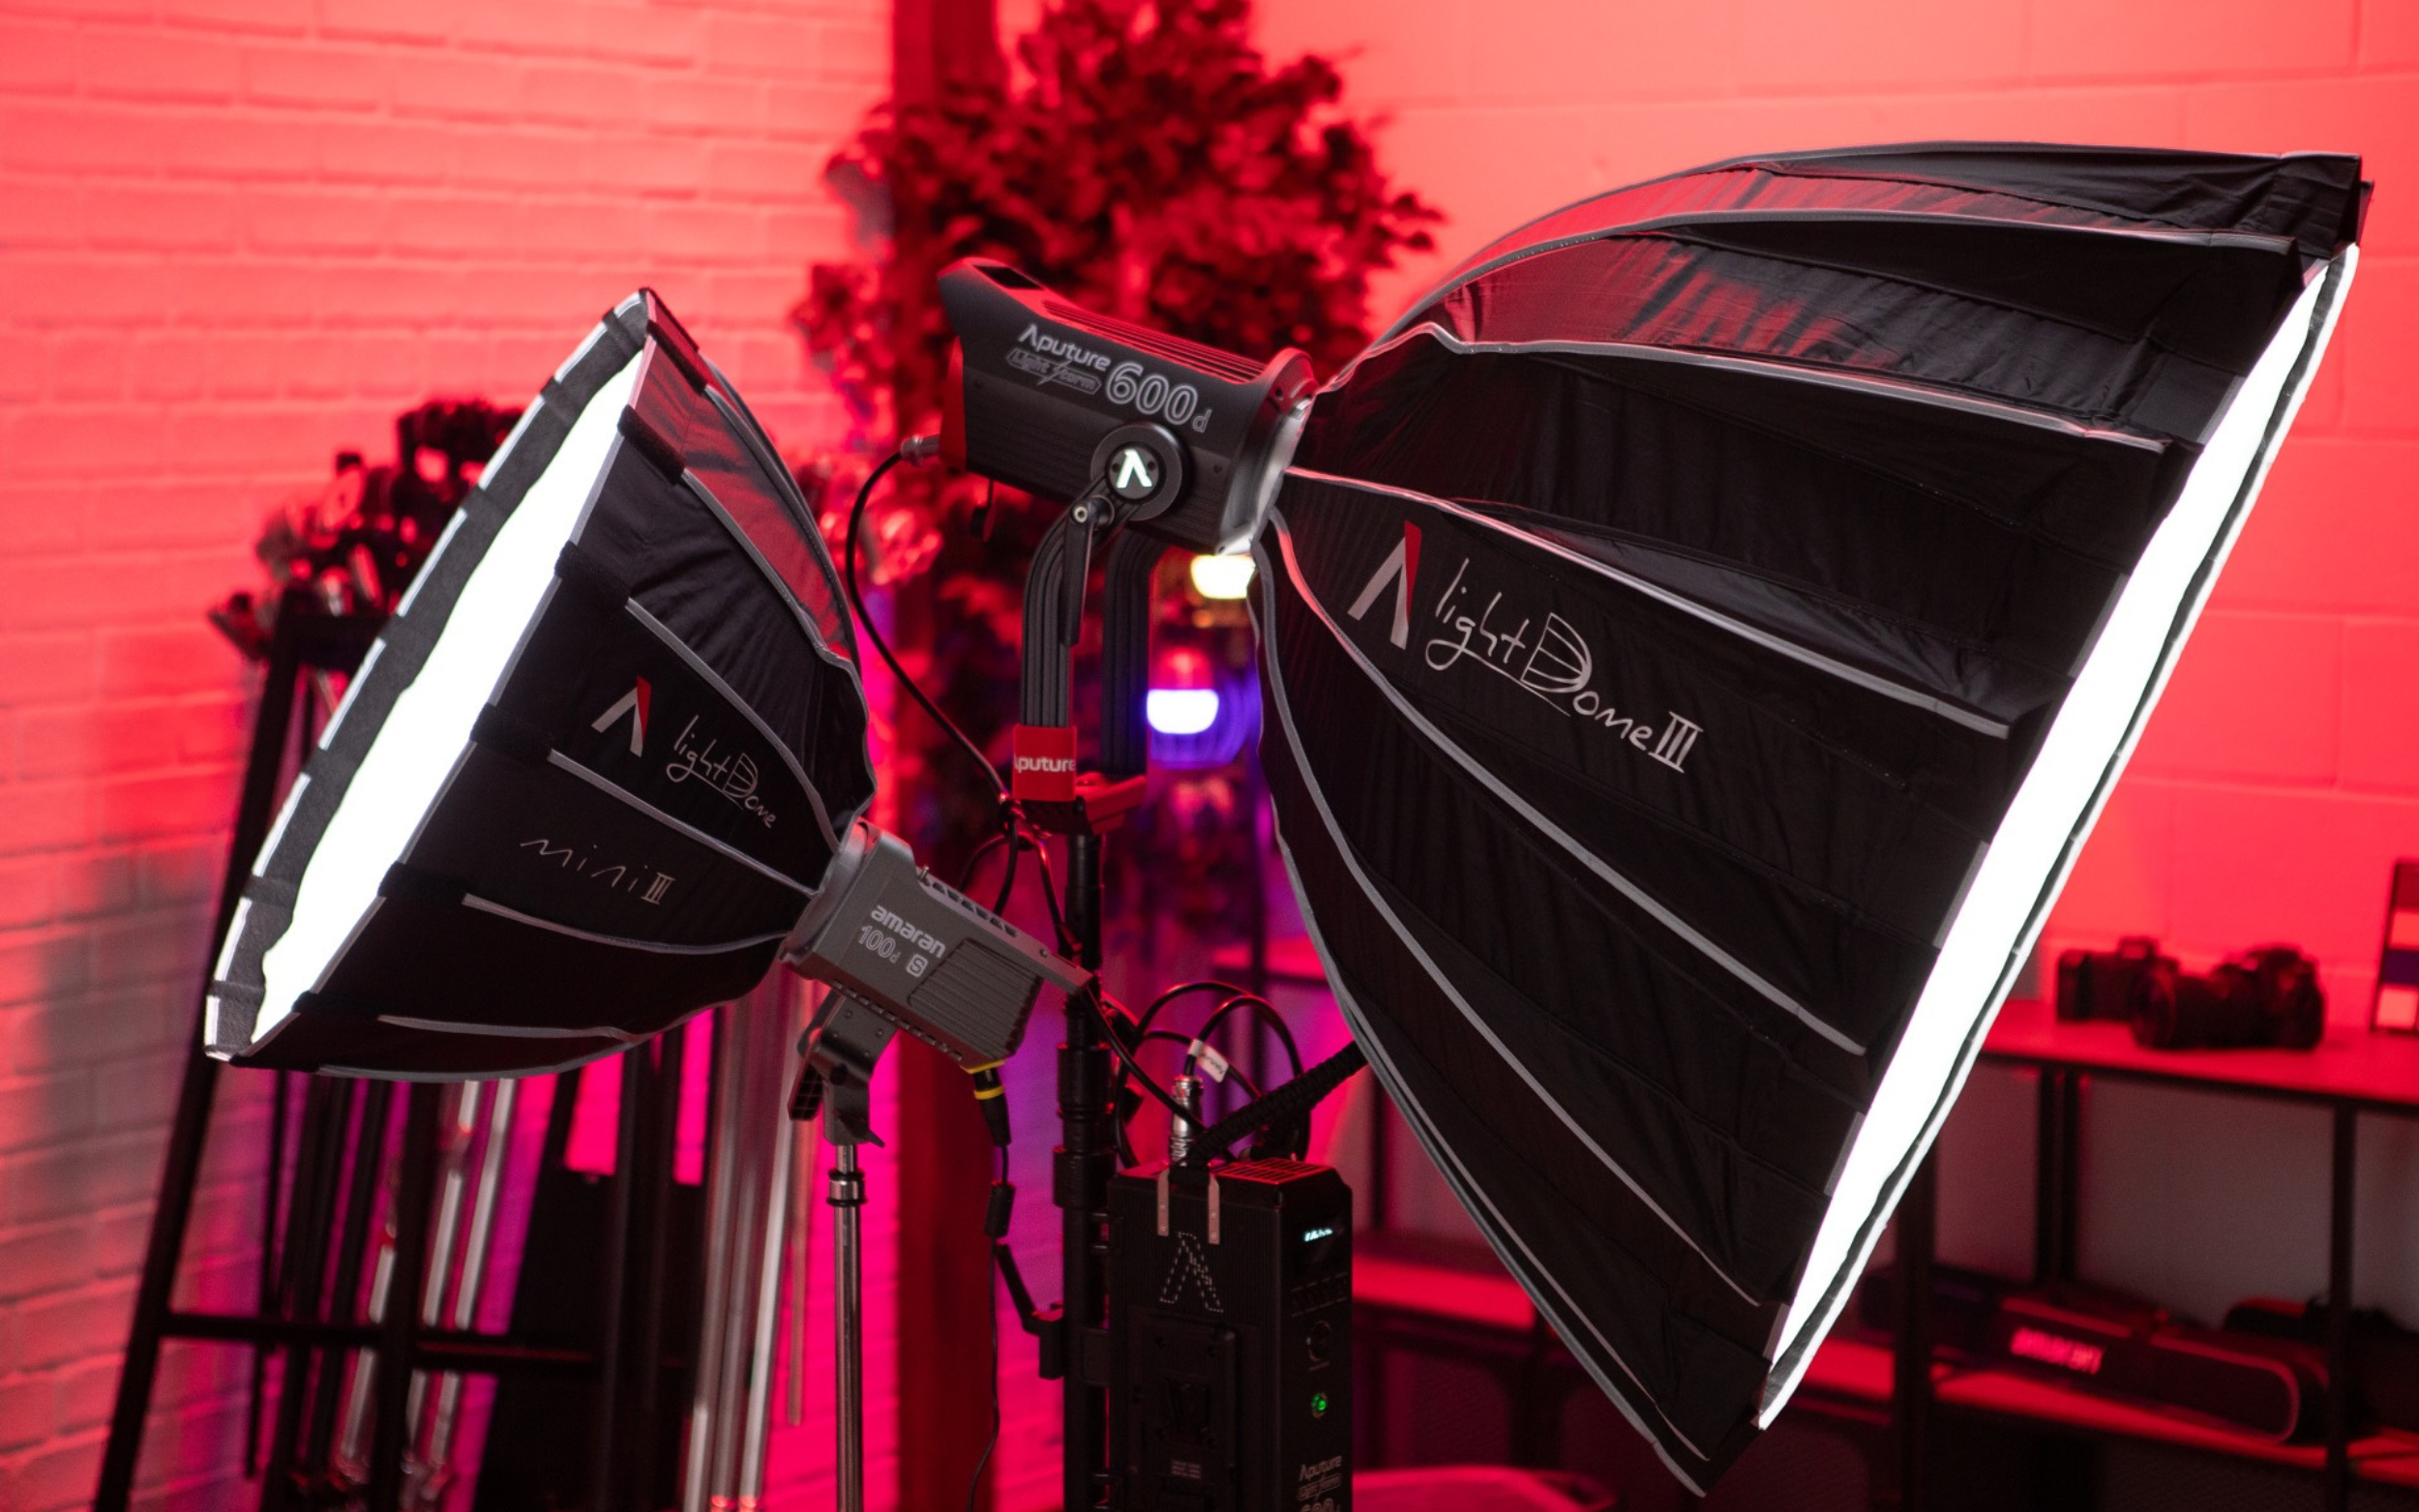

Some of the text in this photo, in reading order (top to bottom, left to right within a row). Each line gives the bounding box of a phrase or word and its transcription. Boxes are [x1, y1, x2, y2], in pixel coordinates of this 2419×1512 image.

[1018, 323, 1112, 371] Aputure
[1014, 755, 1076, 773] puture
[520, 838, 648, 892] mini
[871, 904, 946, 959] amaran
